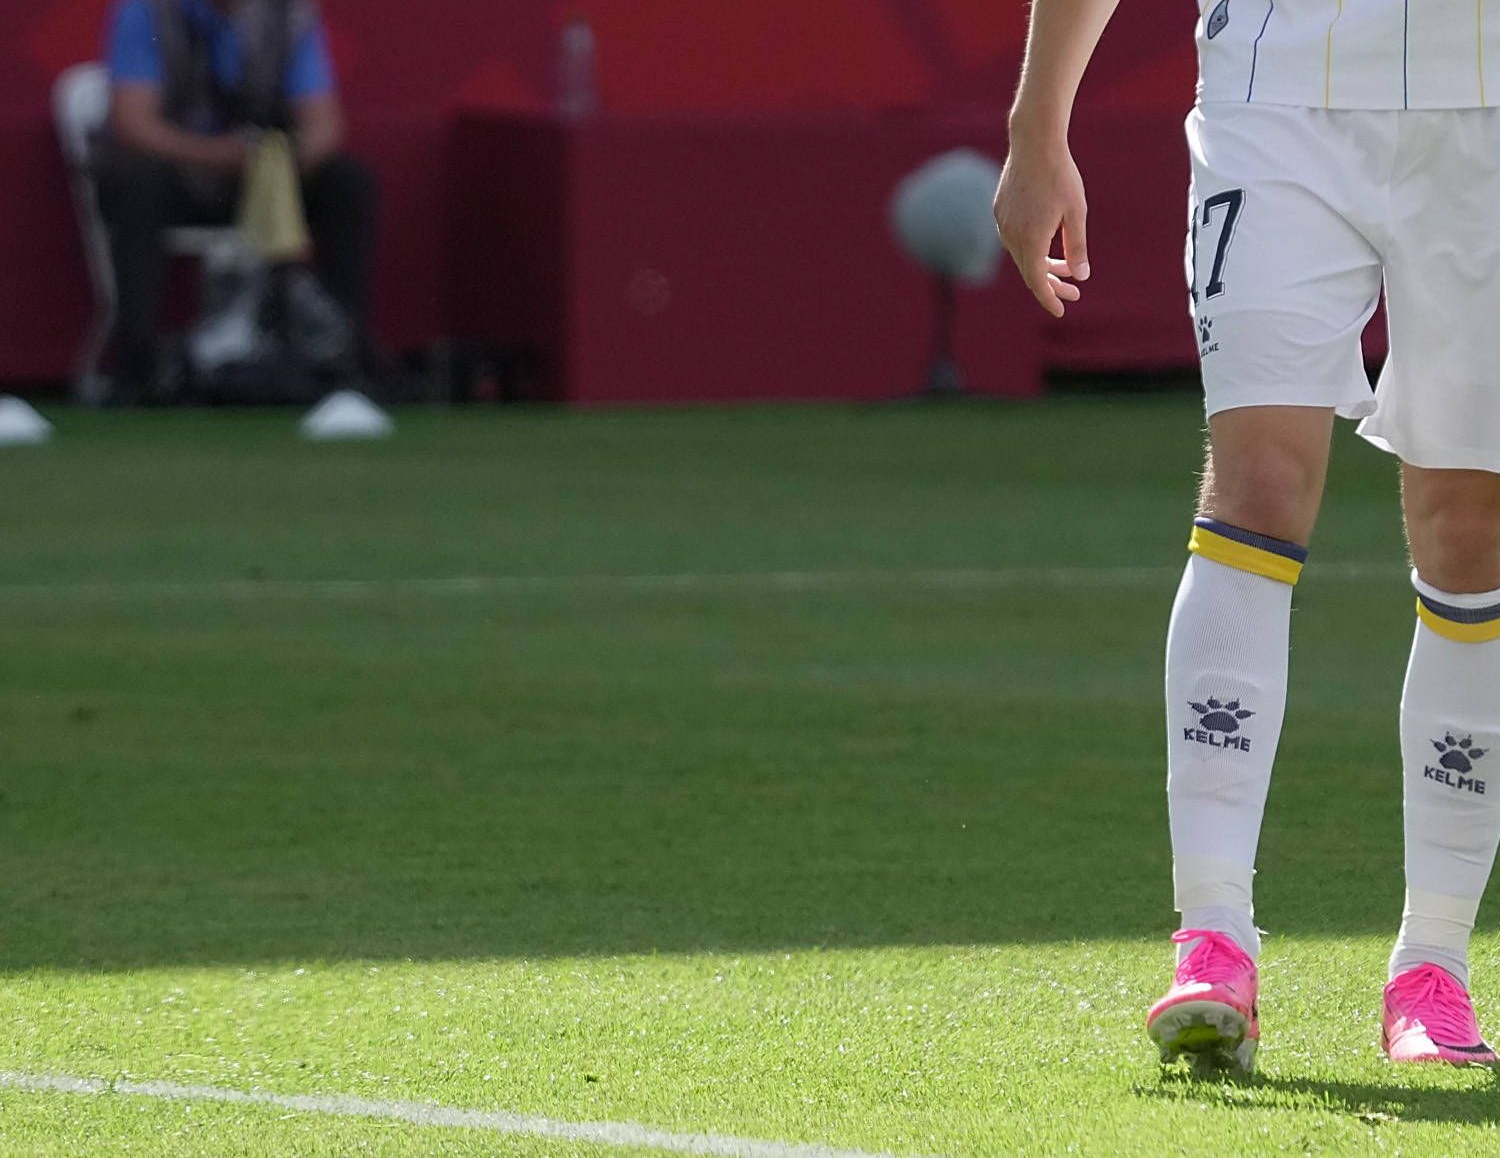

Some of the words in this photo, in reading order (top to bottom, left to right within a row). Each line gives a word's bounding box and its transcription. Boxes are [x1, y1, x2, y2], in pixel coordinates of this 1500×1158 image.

[1200, 342, 1220, 358] ELME
[1183, 726, 1252, 753] KELME
[1423, 764, 1487, 795] KELME
